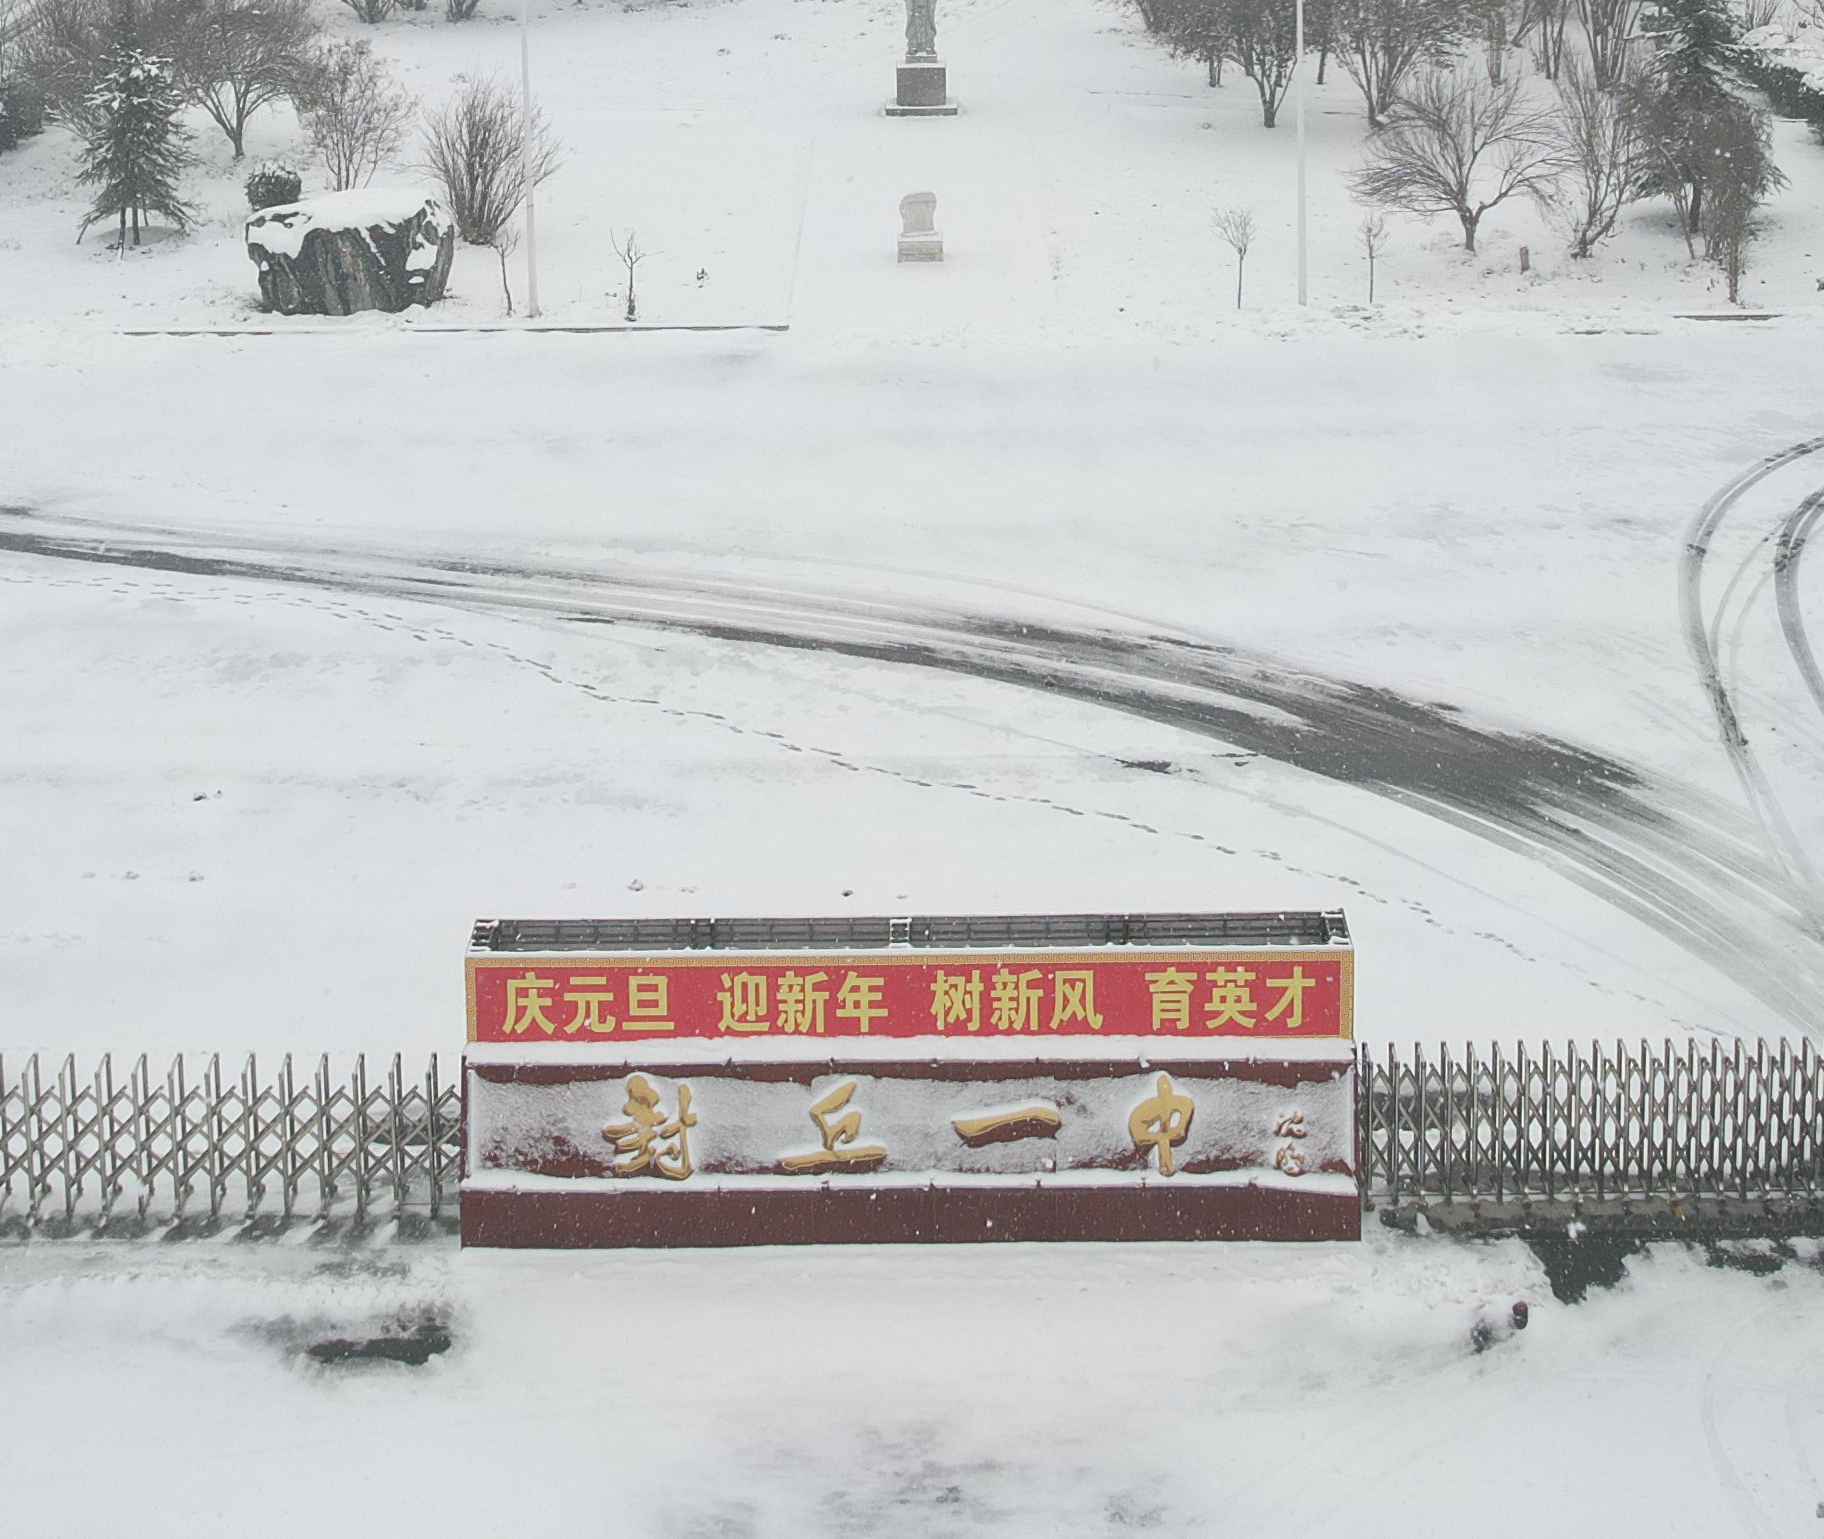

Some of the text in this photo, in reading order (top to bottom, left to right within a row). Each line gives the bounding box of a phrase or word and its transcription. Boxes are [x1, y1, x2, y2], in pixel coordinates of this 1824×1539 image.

[502, 967, 1315, 1034] 庆元旦 迎新年 树新风 育英才
[602, 1073, 1194, 1180] 封丘一中
